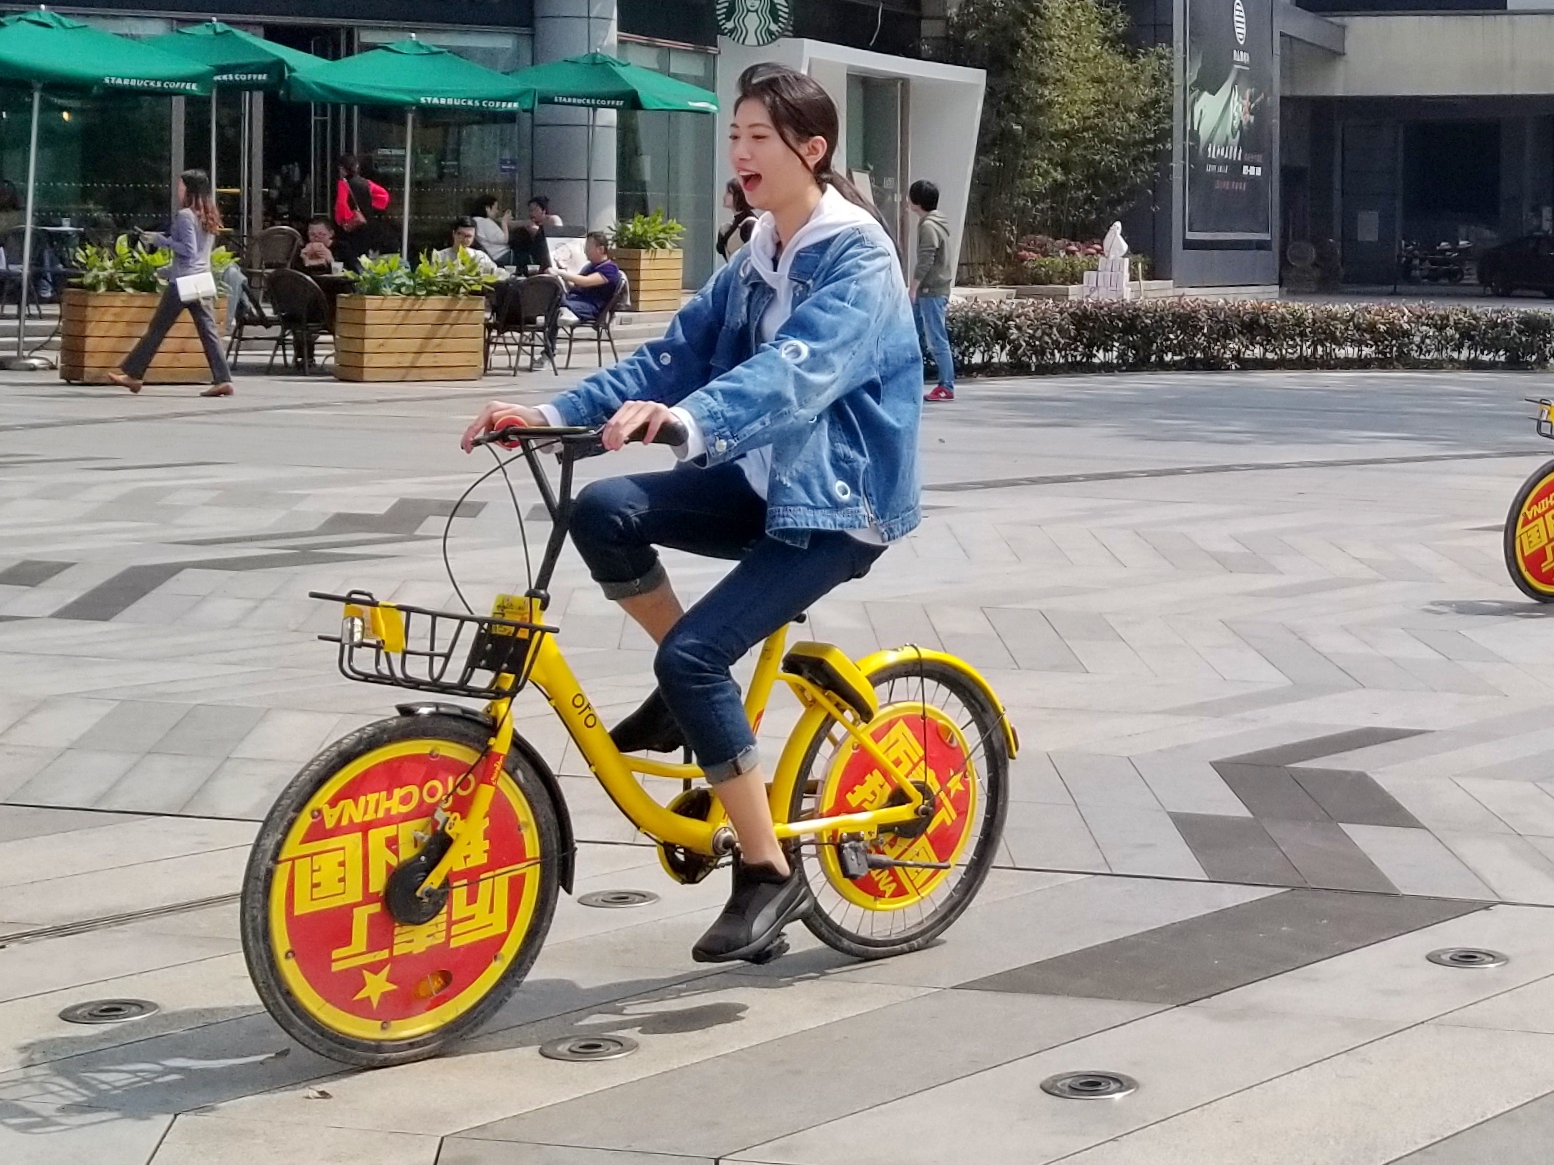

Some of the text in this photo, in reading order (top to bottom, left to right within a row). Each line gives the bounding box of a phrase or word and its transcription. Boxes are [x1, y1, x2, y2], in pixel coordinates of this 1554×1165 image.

[103, 76, 198, 91] STARBUCKS COFFEE
[235, 73, 268, 81] COFFEE
[420, 96, 519, 109] STARBUCKS COFFEE
[554, 96, 625, 106] STARBUCKS COFFEE
[571, 692, 597, 729] ofo
[322, 783, 420, 830] CHINA
